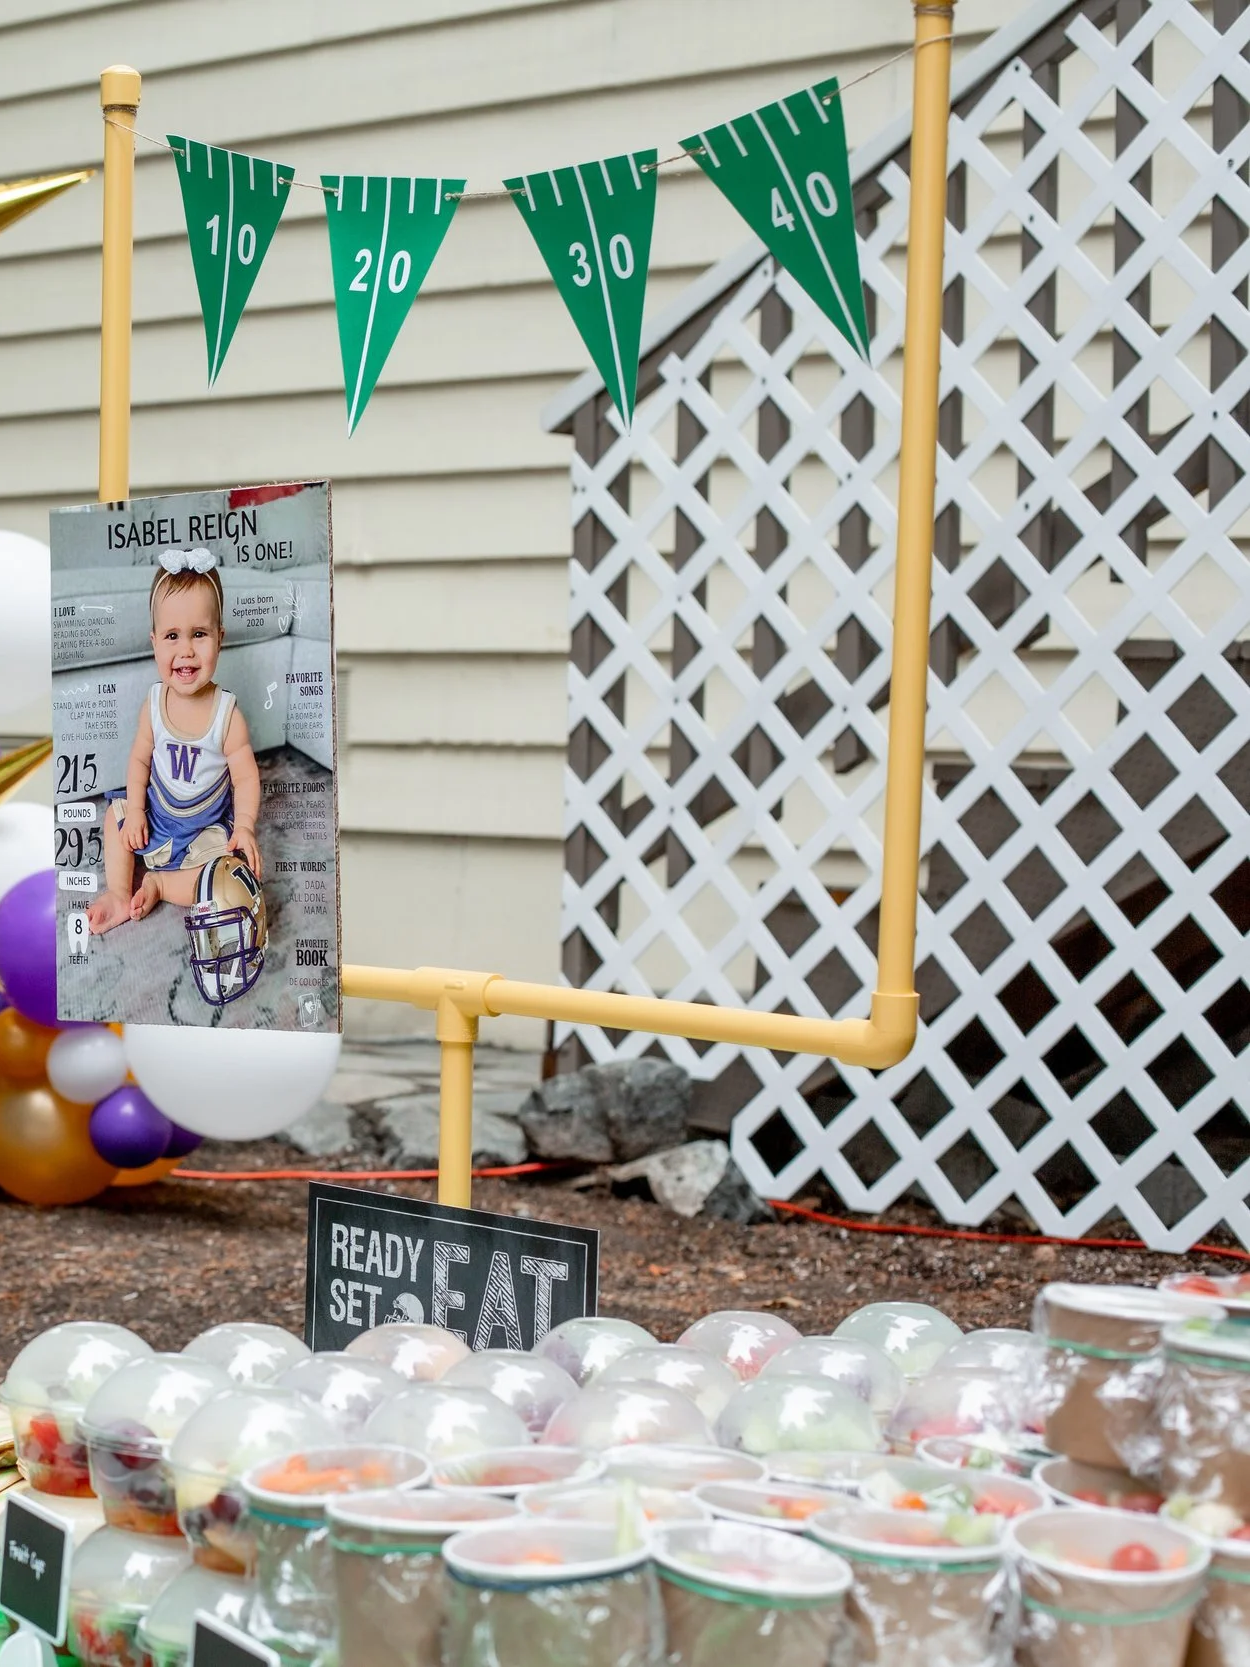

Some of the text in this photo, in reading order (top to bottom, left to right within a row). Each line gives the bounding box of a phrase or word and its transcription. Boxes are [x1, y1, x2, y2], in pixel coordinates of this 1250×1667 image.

[769, 171, 839, 233] 40
[206, 214, 257, 265] 10
[568, 233, 635, 287] 30
[349, 248, 412, 293] 20
[108, 509, 258, 550] ISABEL REIGN
[237, 540, 293, 563] IS ONE!
[240, 597, 256, 605] was
[256, 595, 274, 604] born
[58, 606, 76, 617] LOVE
[232, 605, 279, 618] September 11
[246, 617, 265, 628] 2020
[285, 671, 324, 684] FAVORITE
[102, 683, 117, 694] CAN
[299, 685, 324, 697] SONGS
[74, 700, 91, 709] WAVE
[75, 731, 92, 741] HUGS
[166, 743, 201, 783] W
[56, 753, 98, 794] 21.5
[263, 782, 326, 794] FAVORITE FOODS
[63, 808, 92, 818] POUNDS
[54, 827, 102, 868] 29.5
[275, 861, 327, 872] FIRST WORDS
[66, 876, 91, 886] INCHES
[71, 900, 90, 910] HAVE
[303, 905, 328, 915] MAMA
[74, 918, 83, 935] 8
[295, 939, 328, 949] FAVORITE
[68, 955, 89, 965] TEETH
[295, 949, 329, 967] BOOK
[331, 1223, 424, 1283] READY
[432, 1240, 569, 1351] EAT
[329, 1278, 383, 1329] SET
